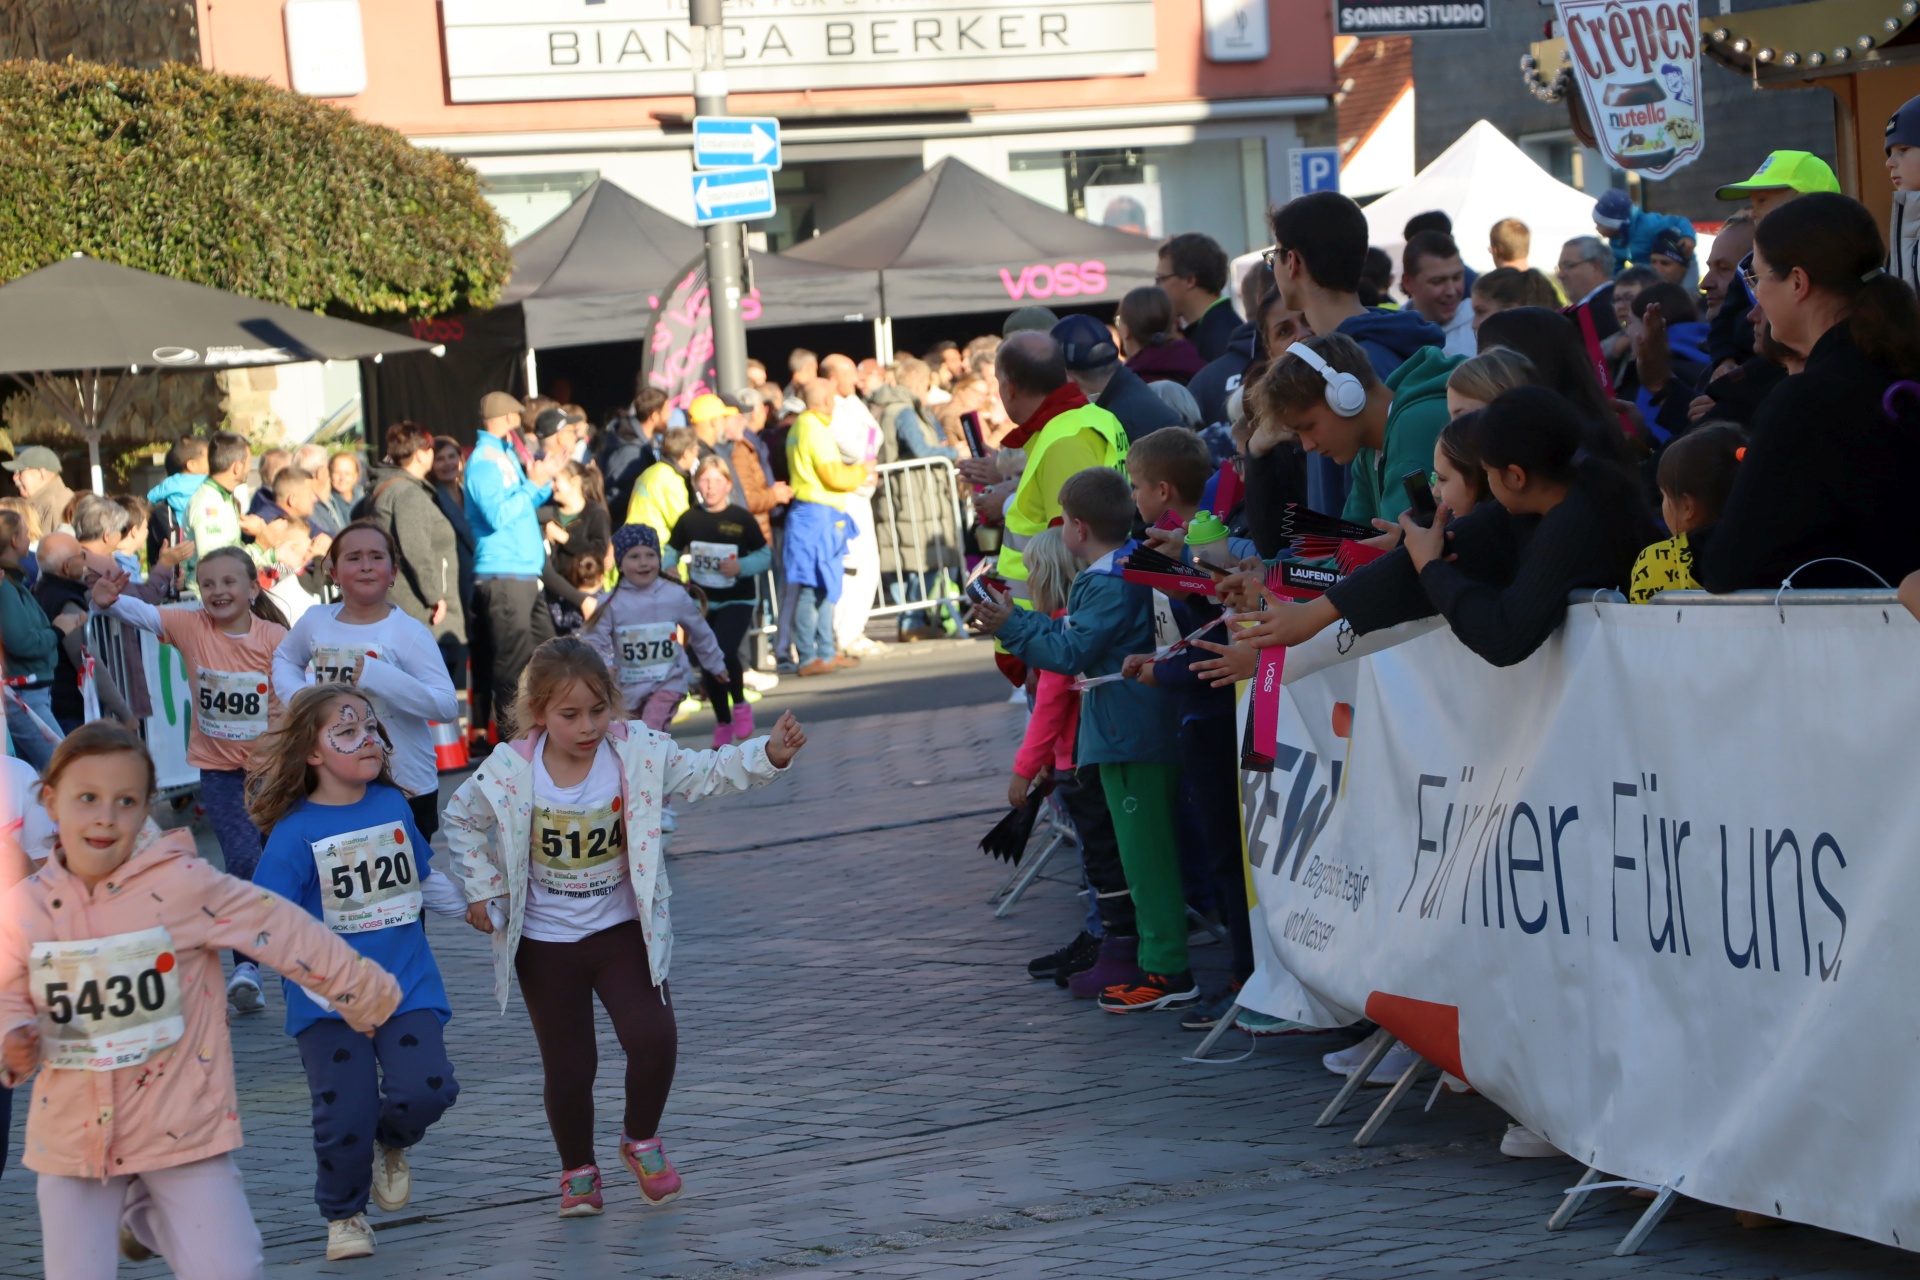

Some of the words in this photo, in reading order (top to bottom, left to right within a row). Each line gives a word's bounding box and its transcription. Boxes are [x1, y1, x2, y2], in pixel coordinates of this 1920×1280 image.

[1341, 4, 1484, 28] SONNENSTUDIO
[549, 23, 793, 66] BIANCA
[826, 13, 1070, 56] BERKER
[1567, 0, 1696, 79] Crêpes
[1609, 103, 1667, 128] nutella
[1309, 157, 1330, 189] P
[1000, 260, 1108, 300] VOSS
[411, 315, 464, 343] VOSS
[1179, 580, 1207, 590] VOSS
[1290, 567, 1335, 582] LAUFEND
[623, 639, 674, 661] 5378
[1263, 661, 1277, 693] VOSS
[200, 687, 260, 715] 5498
[542, 818, 623, 858] 5124
[331, 851, 412, 899] 5120
[1612, 771, 1692, 957] Für
[589, 878, 608, 889] BEW
[332, 924, 349, 932] AOK
[358, 919, 384, 930] VOSS
[384, 915, 403, 926] BEW
[1283, 907, 1309, 939] und
[45, 968, 166, 1024] 5430
